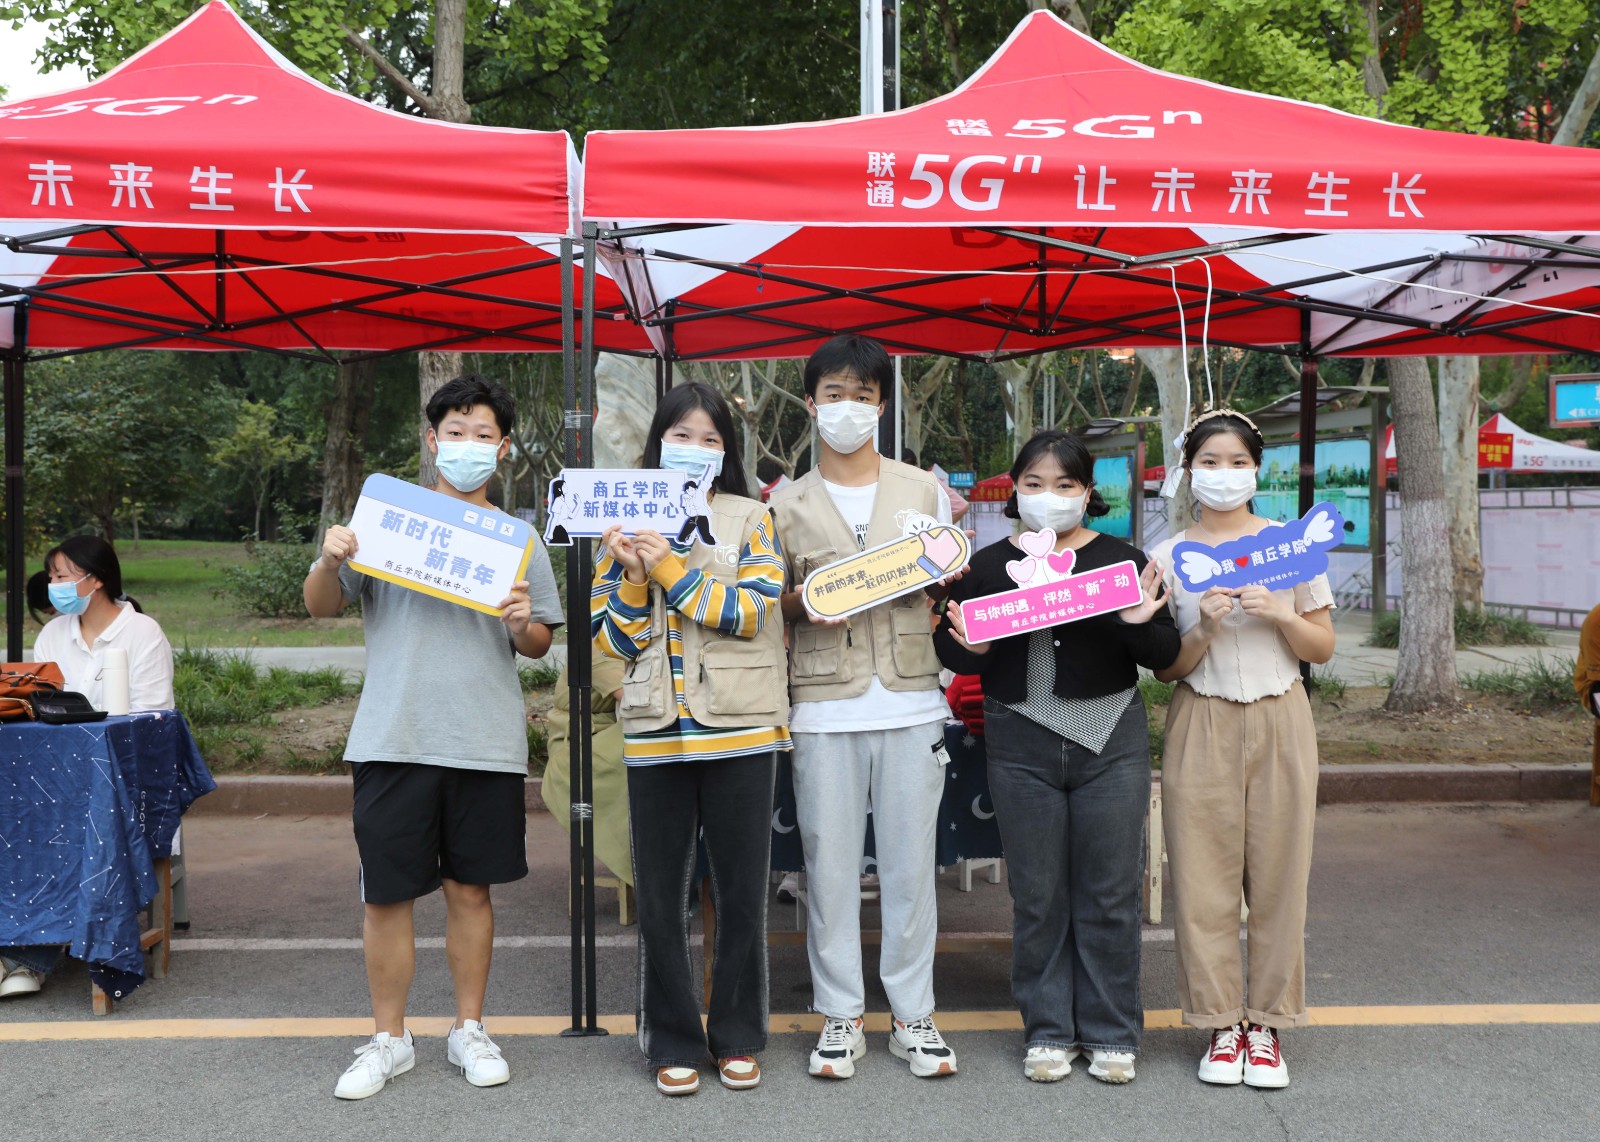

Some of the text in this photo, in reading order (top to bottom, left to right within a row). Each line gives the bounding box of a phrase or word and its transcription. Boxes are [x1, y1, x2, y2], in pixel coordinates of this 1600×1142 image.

[945, 110, 1203, 139] 联通 5Gn
[28, 159, 314, 214] 未来生长
[865, 151, 1427, 218] 联通 5Gn 让未来生长
[593, 480, 669, 499] 商丘学院
[583, 500, 679, 519] 新媒体中心
[380, 509, 453, 549] 新时代
[423, 547, 496, 586] 新青年
[1220, 539, 1308, 575] 我 商丘学院
[384, 559, 472, 594] 商丘学院新媒体中心
[855, 562, 919, 591] 一起闪闪发光
[1010, 602, 1096, 629] 商丘学院新媒体中心
